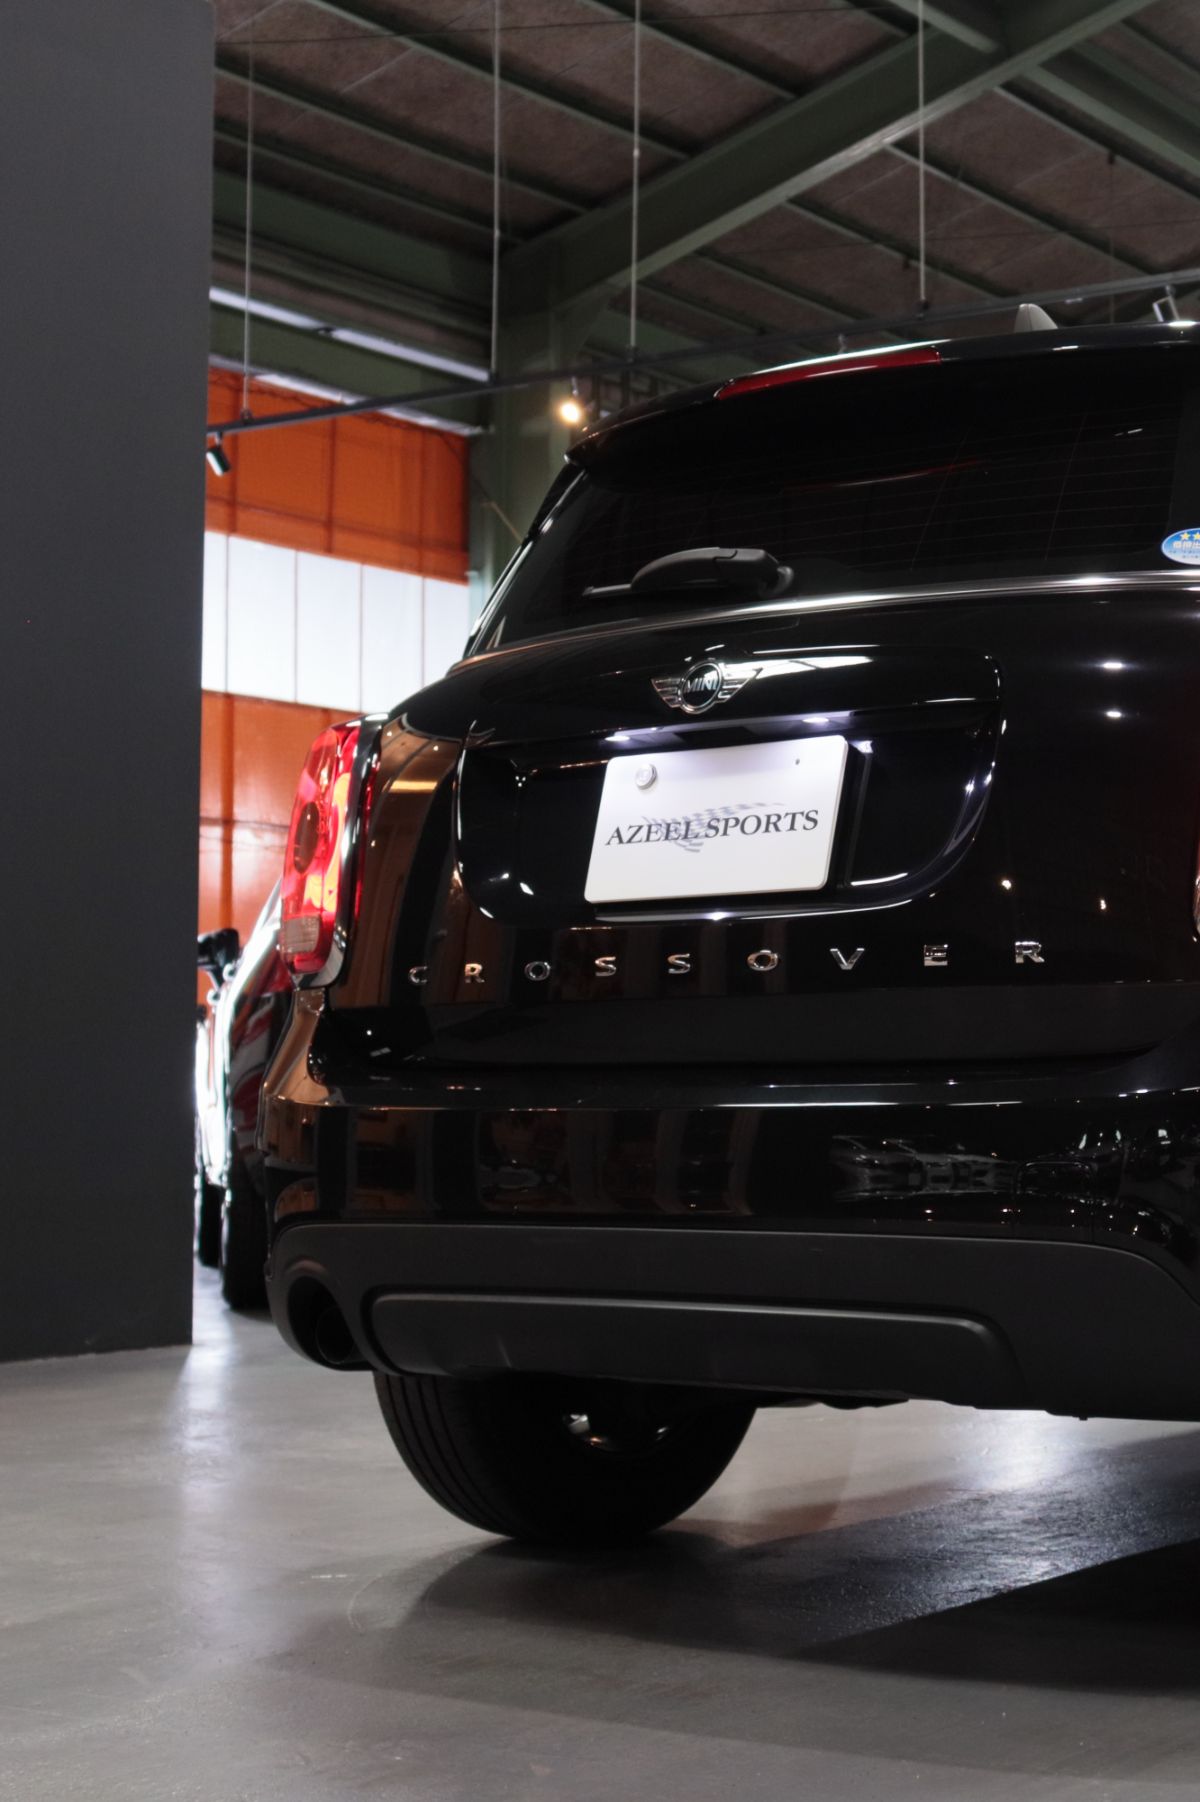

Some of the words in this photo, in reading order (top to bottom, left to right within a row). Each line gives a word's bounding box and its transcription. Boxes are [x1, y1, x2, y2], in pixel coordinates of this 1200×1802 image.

[684, 677, 718, 693] MINI
[604, 820, 700, 846] AZEEL
[704, 809, 819, 839] SPORTS
[408, 940, 1045, 985] CROSSOVER
